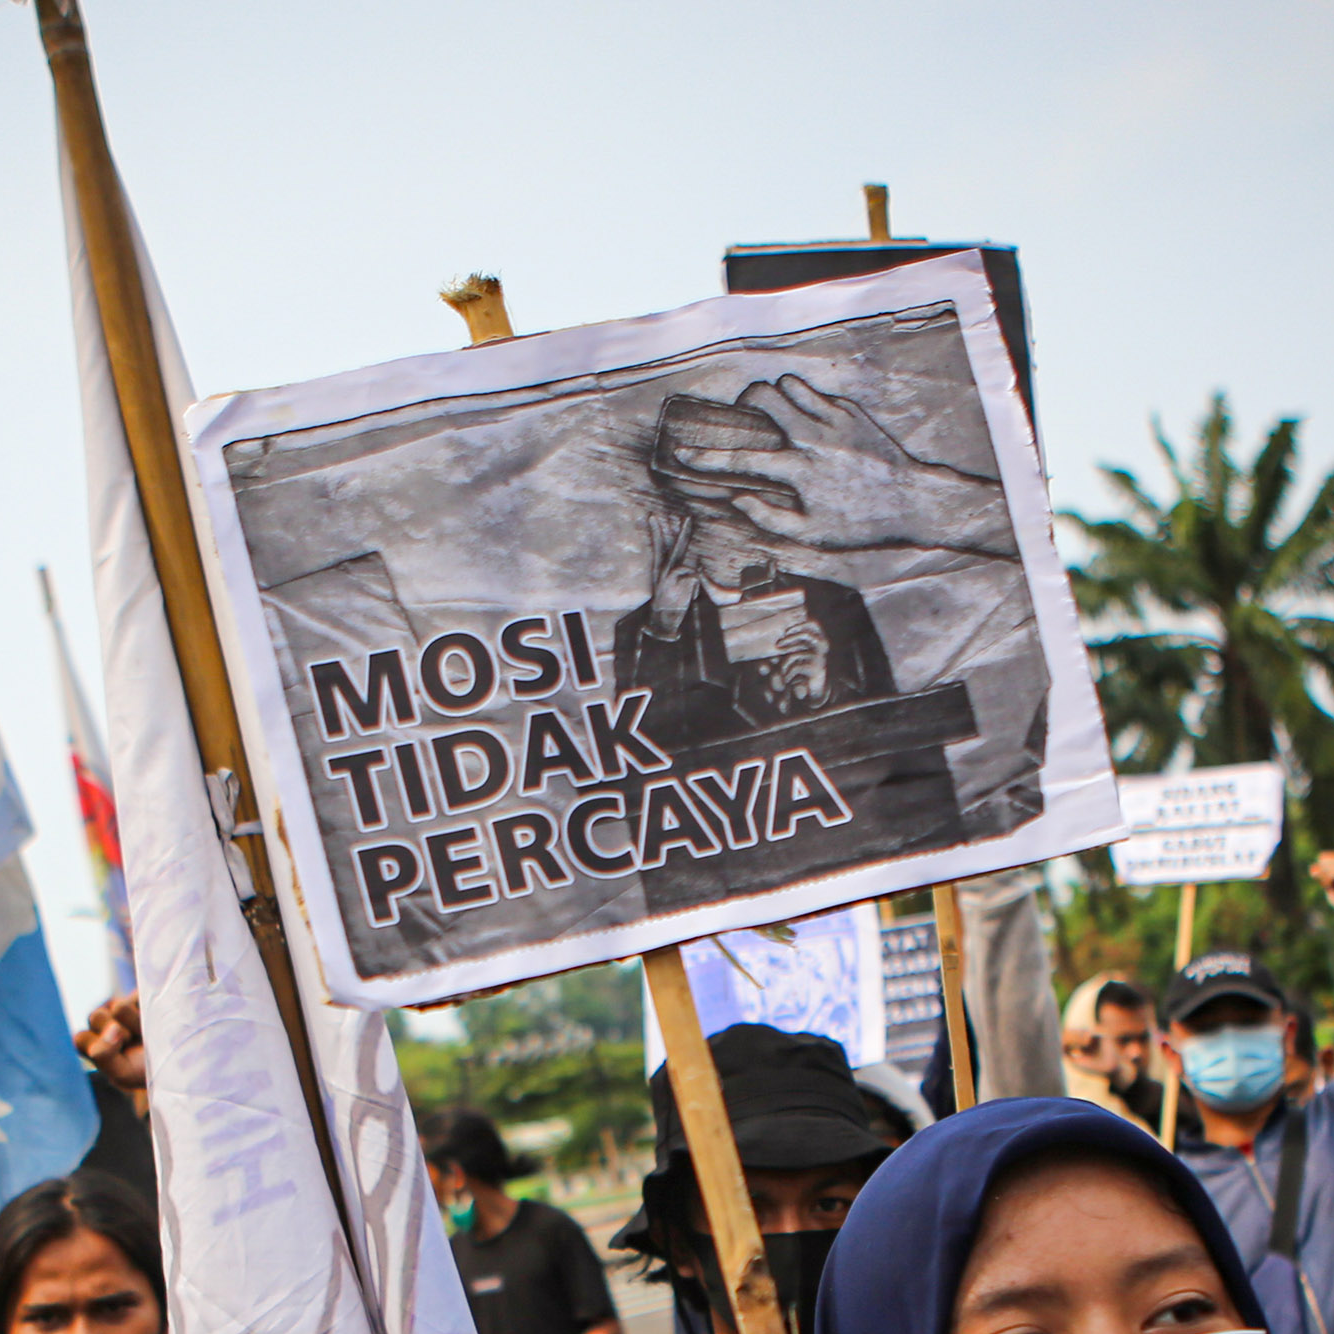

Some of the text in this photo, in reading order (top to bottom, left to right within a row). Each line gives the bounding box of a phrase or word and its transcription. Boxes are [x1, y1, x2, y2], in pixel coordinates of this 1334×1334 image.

[308, 609, 603, 742] MOSI
[325, 689, 672, 832] TIDAK
[352, 749, 854, 928] PERCAYA
